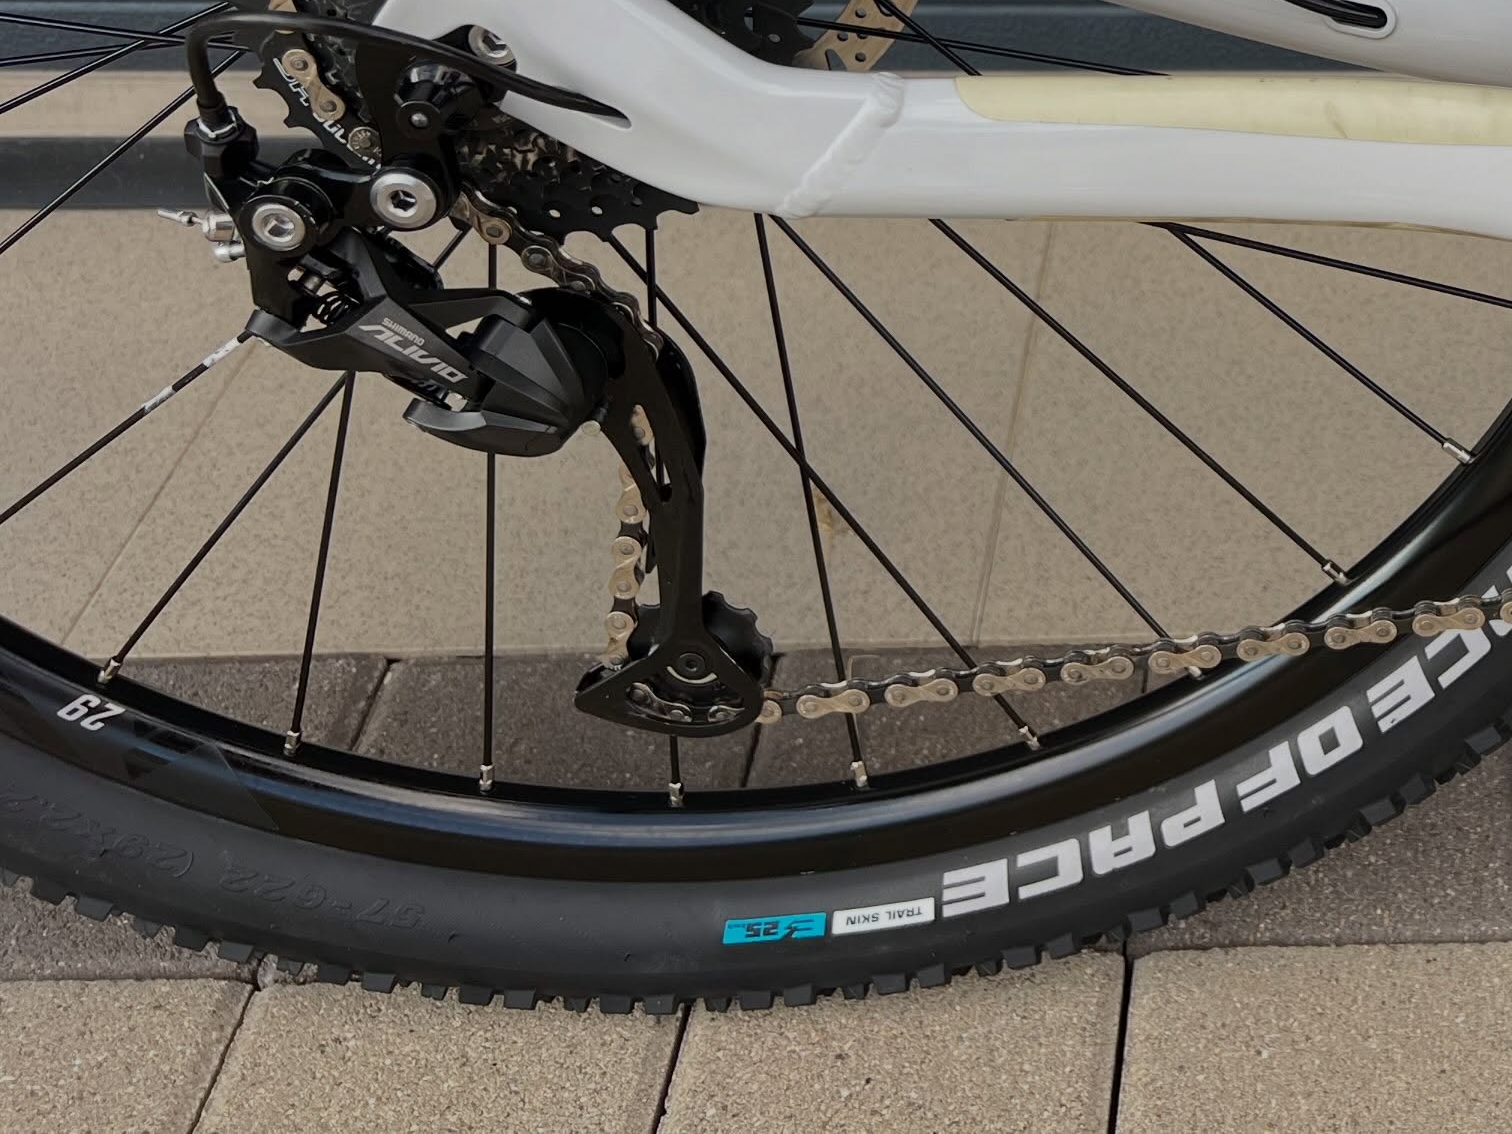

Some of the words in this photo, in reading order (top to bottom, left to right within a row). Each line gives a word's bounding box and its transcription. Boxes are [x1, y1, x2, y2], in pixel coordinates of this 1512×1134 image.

[382, 317, 425, 346] SHIMANO
[358, 325, 469, 383] ALIVIO
[57, 694, 125, 731] 29
[1236, 706, 1363, 813] OF
[942, 779, 1226, 918] PACE
[846, 912, 880, 926] SKIN
[885, 905, 922, 919] TRAIL
